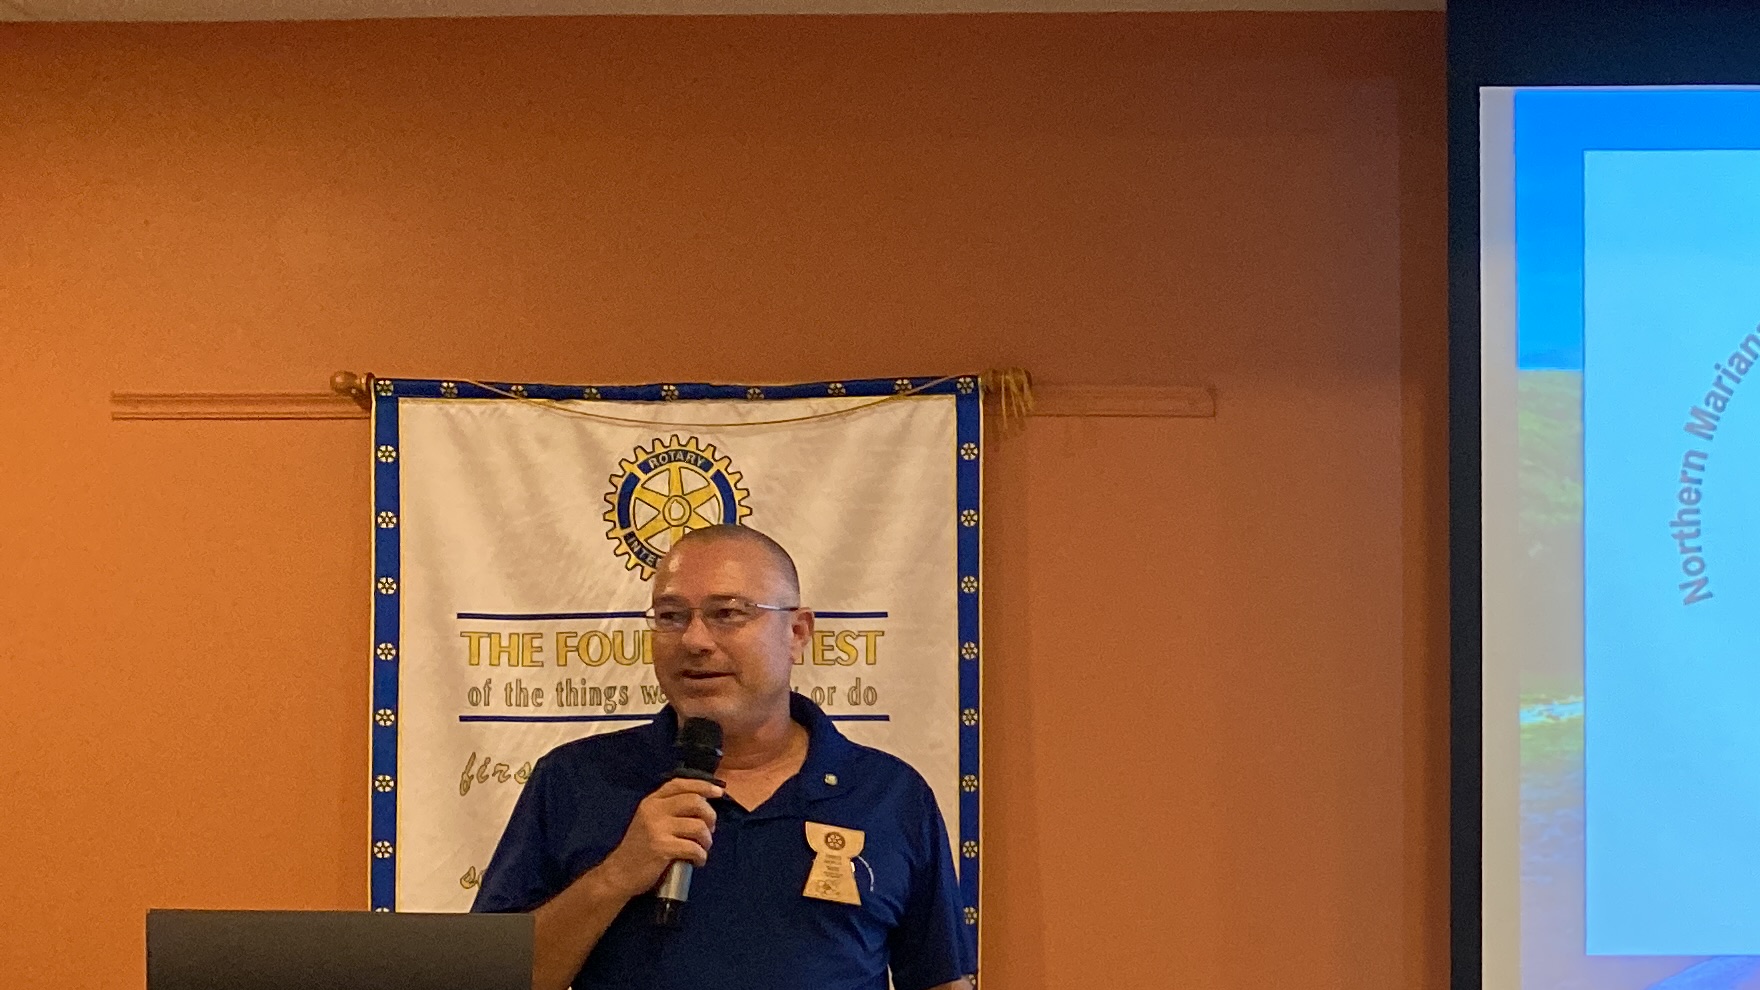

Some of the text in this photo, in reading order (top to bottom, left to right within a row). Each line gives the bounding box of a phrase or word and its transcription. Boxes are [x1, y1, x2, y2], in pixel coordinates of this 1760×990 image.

[648, 450, 706, 469] ROTARY
[1670, 449, 1714, 607] Northern
[460, 631, 544, 667] THE
[467, 678, 491, 706] of
[504, 678, 544, 707] the
[555, 678, 629, 713] things
[811, 686, 836, 706] or
[847, 677, 878, 706] do
